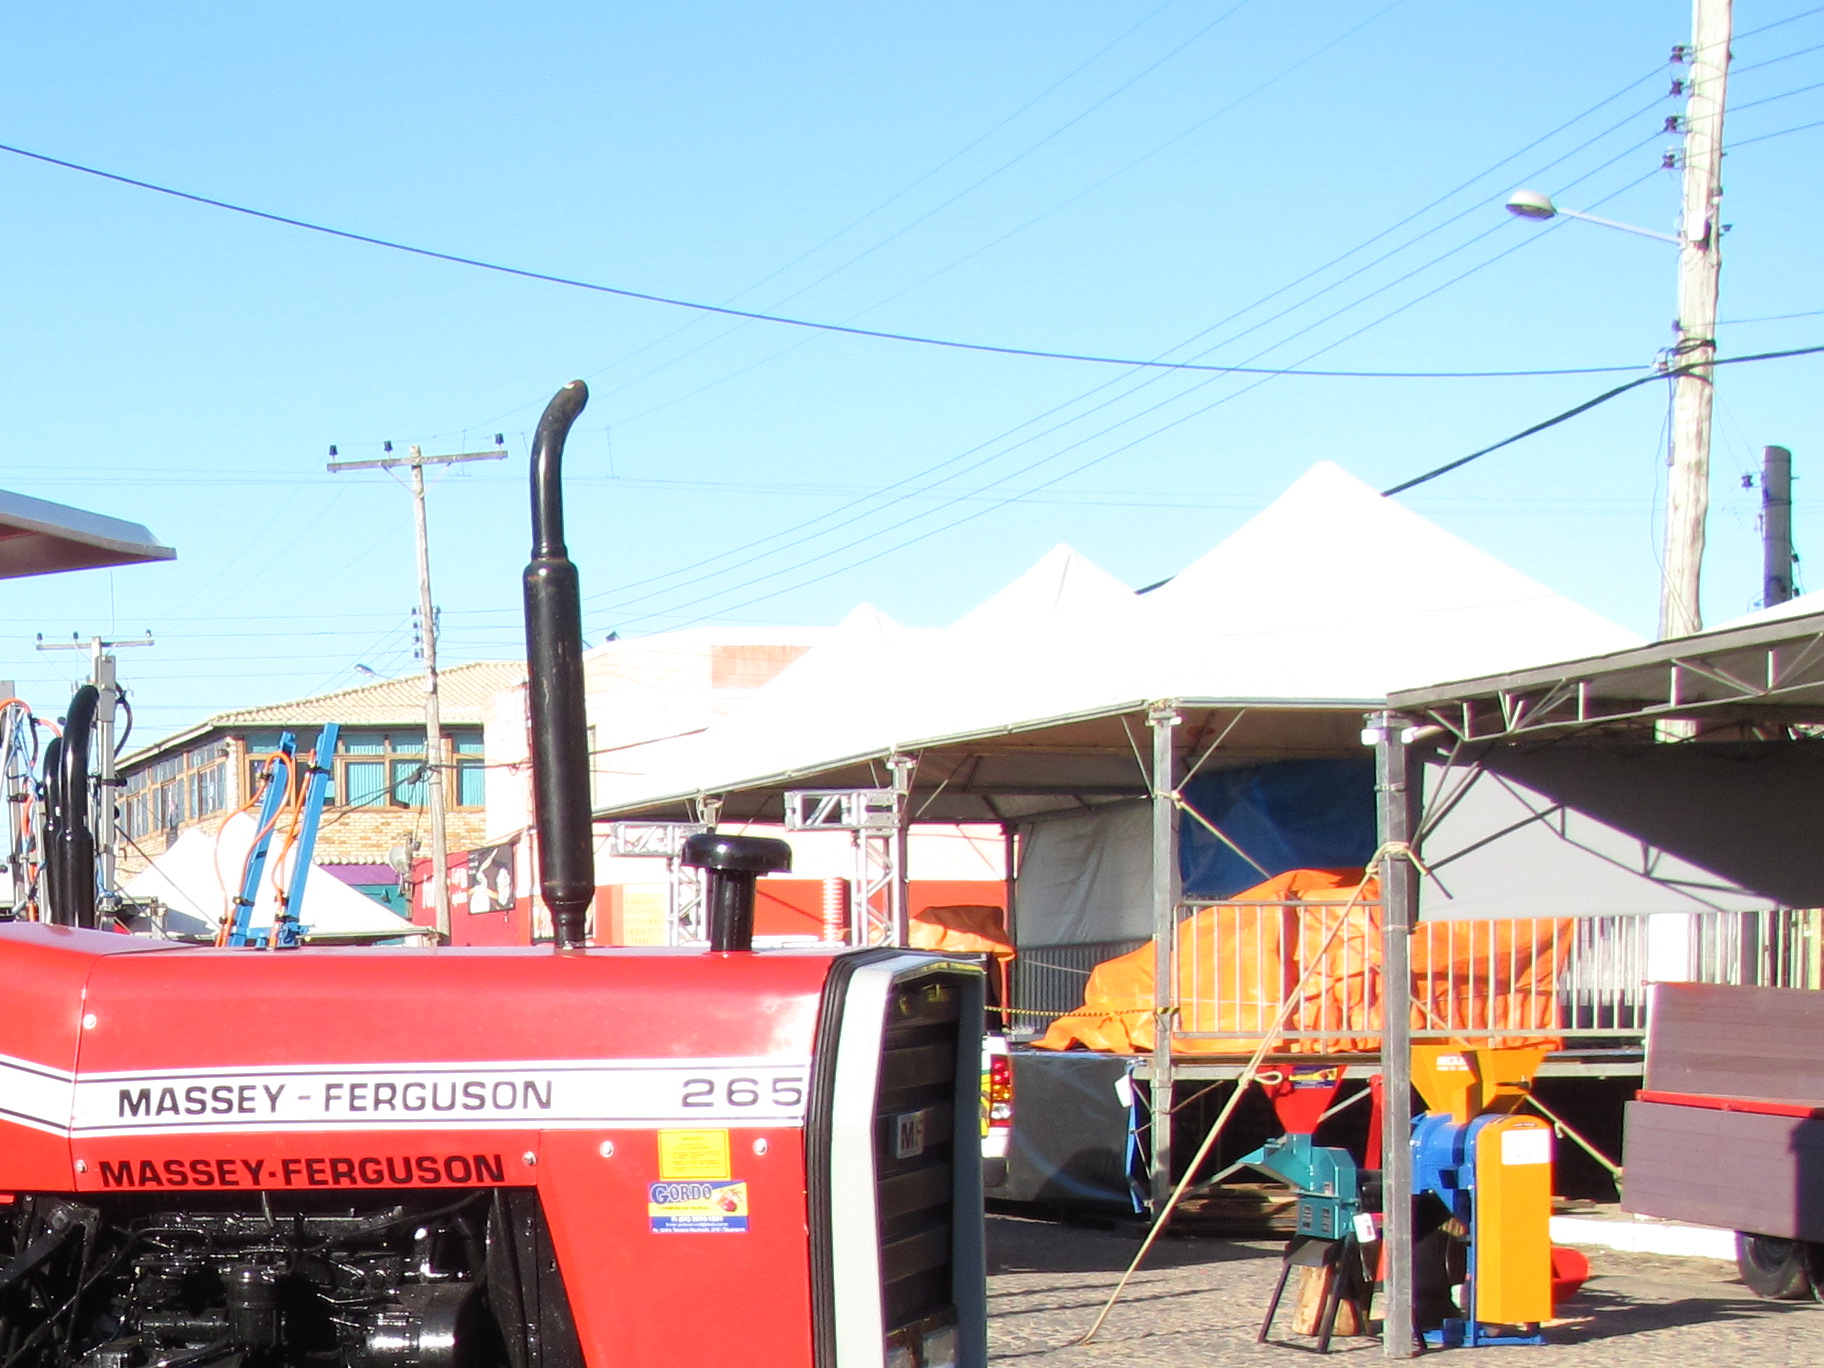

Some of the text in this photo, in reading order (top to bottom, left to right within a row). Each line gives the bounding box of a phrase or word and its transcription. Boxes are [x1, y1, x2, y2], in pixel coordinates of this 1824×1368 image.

[118, 1083, 287, 1118] MASSEY
[323, 1079, 553, 1113] FERGUSON
[680, 1076, 804, 1108] 265
